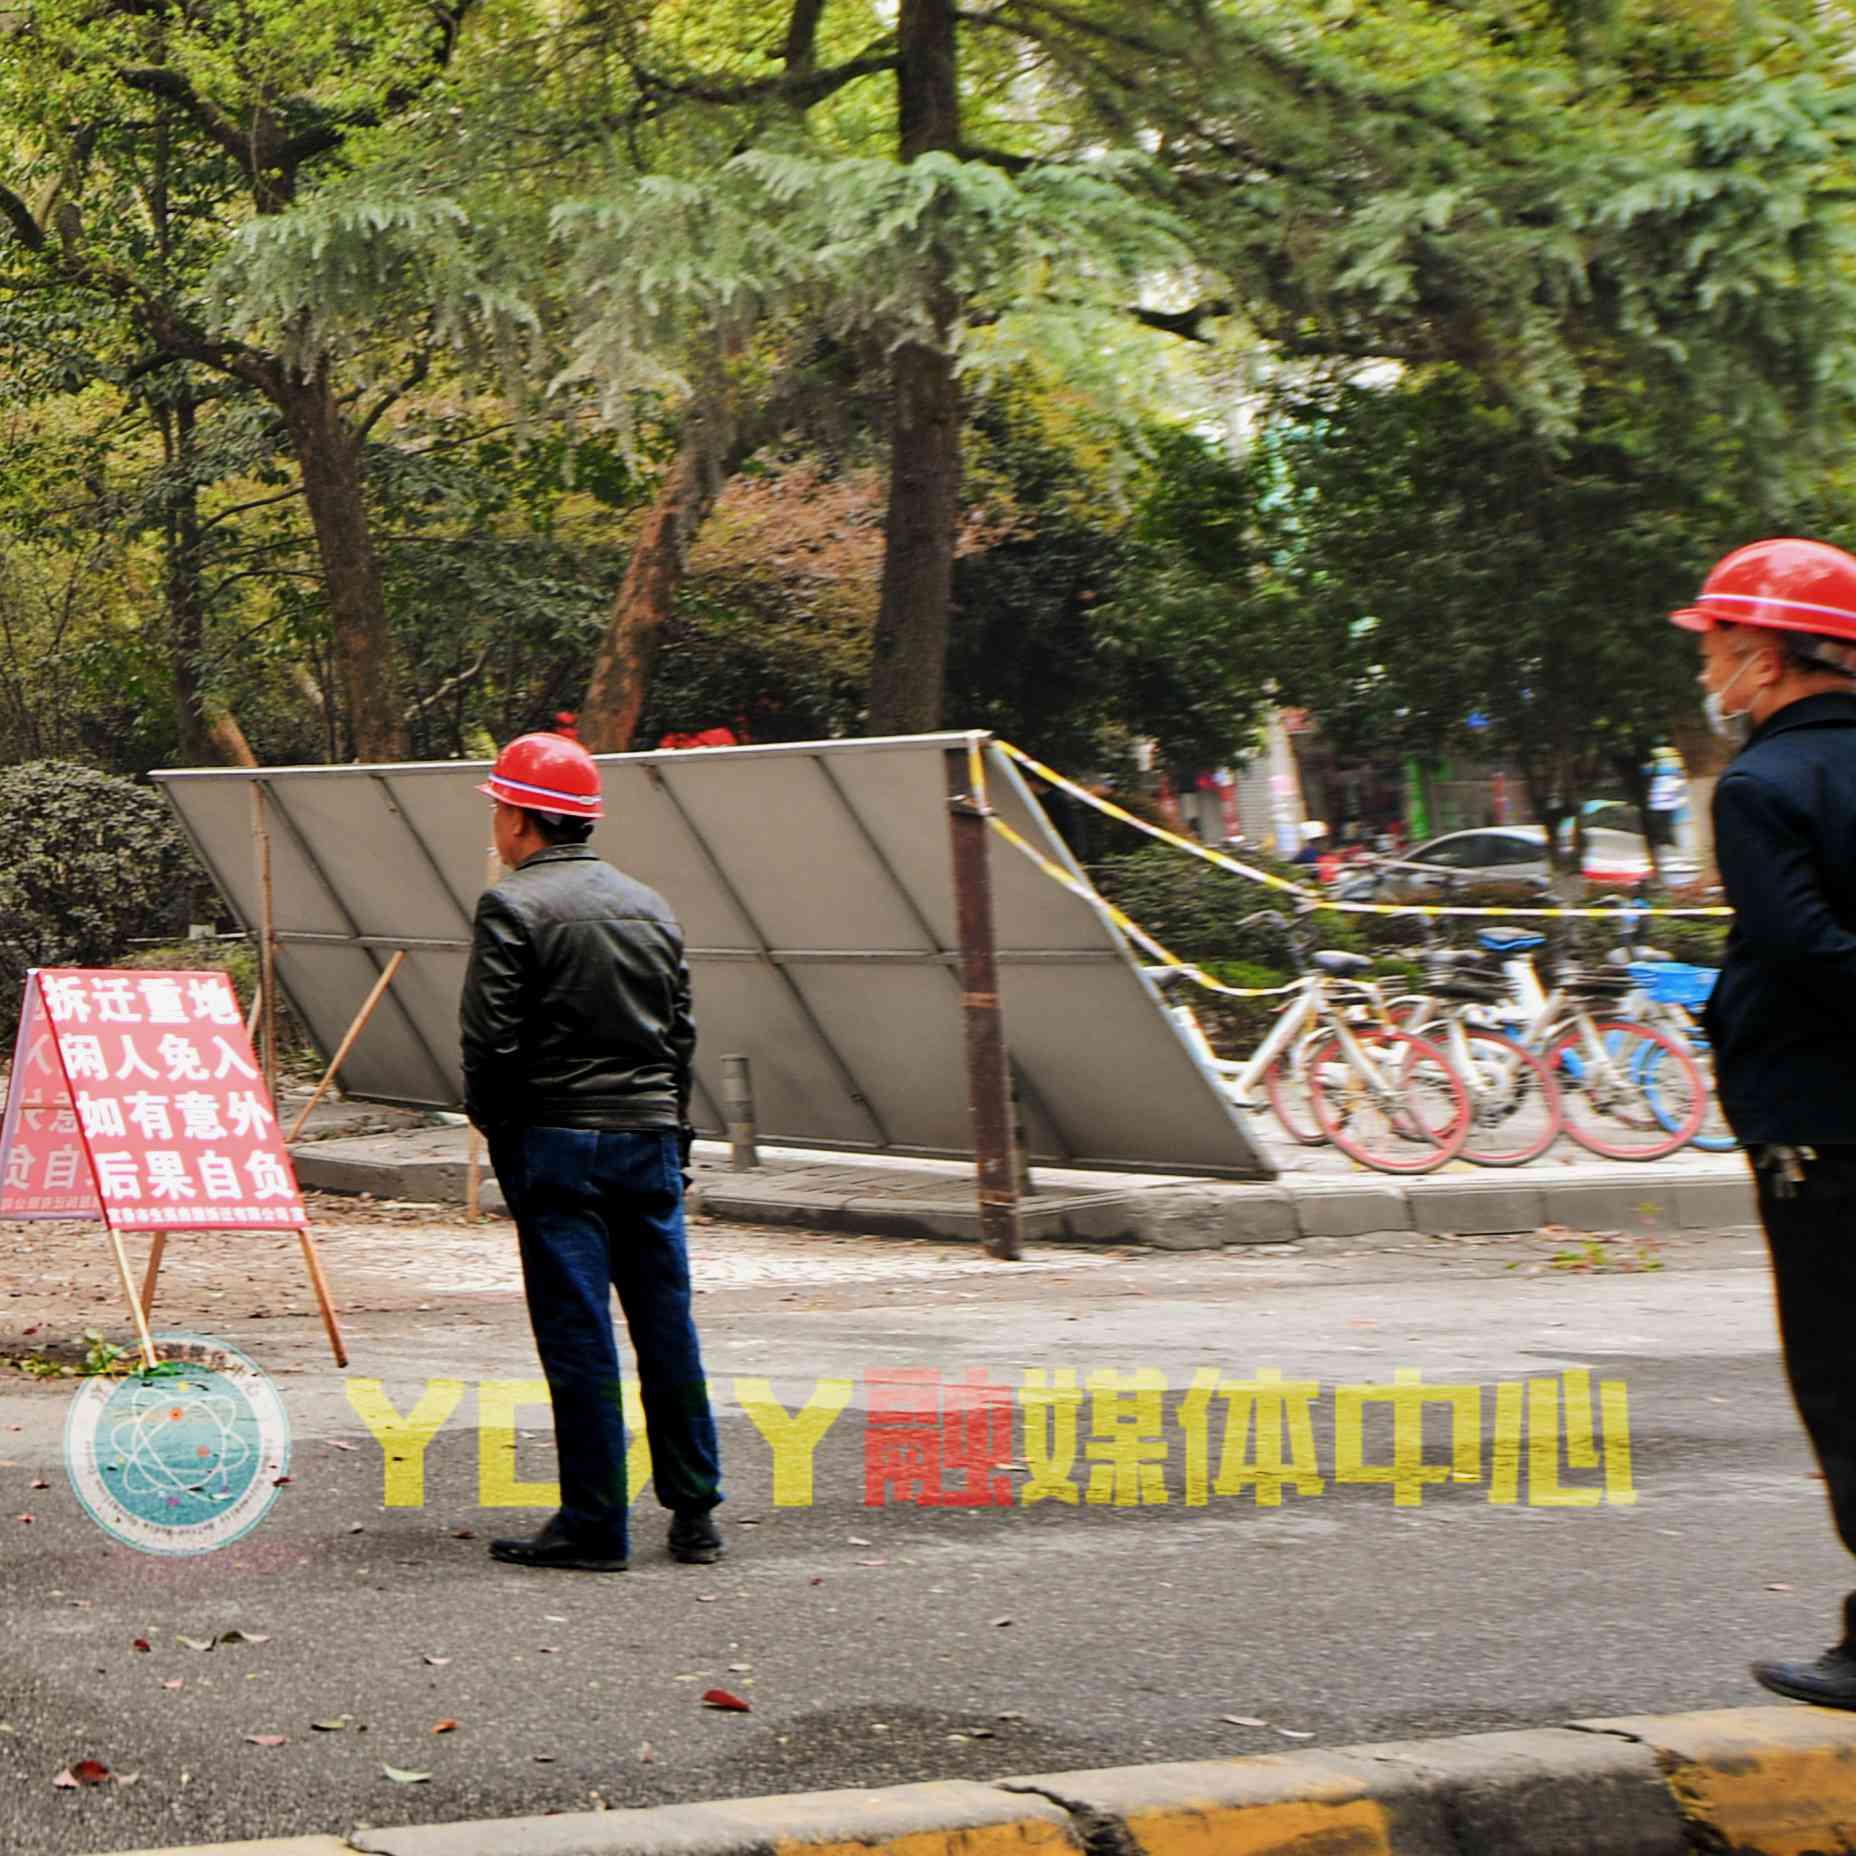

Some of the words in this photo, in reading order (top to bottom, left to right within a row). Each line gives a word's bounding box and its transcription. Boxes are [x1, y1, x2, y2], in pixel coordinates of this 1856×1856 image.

[44, 975, 241, 1025] 拆迁重地
[61, 1033, 259, 1081] 闲人免入
[77, 1090, 274, 1140] 如有意外
[98, 1150, 295, 1201] 后果自负
